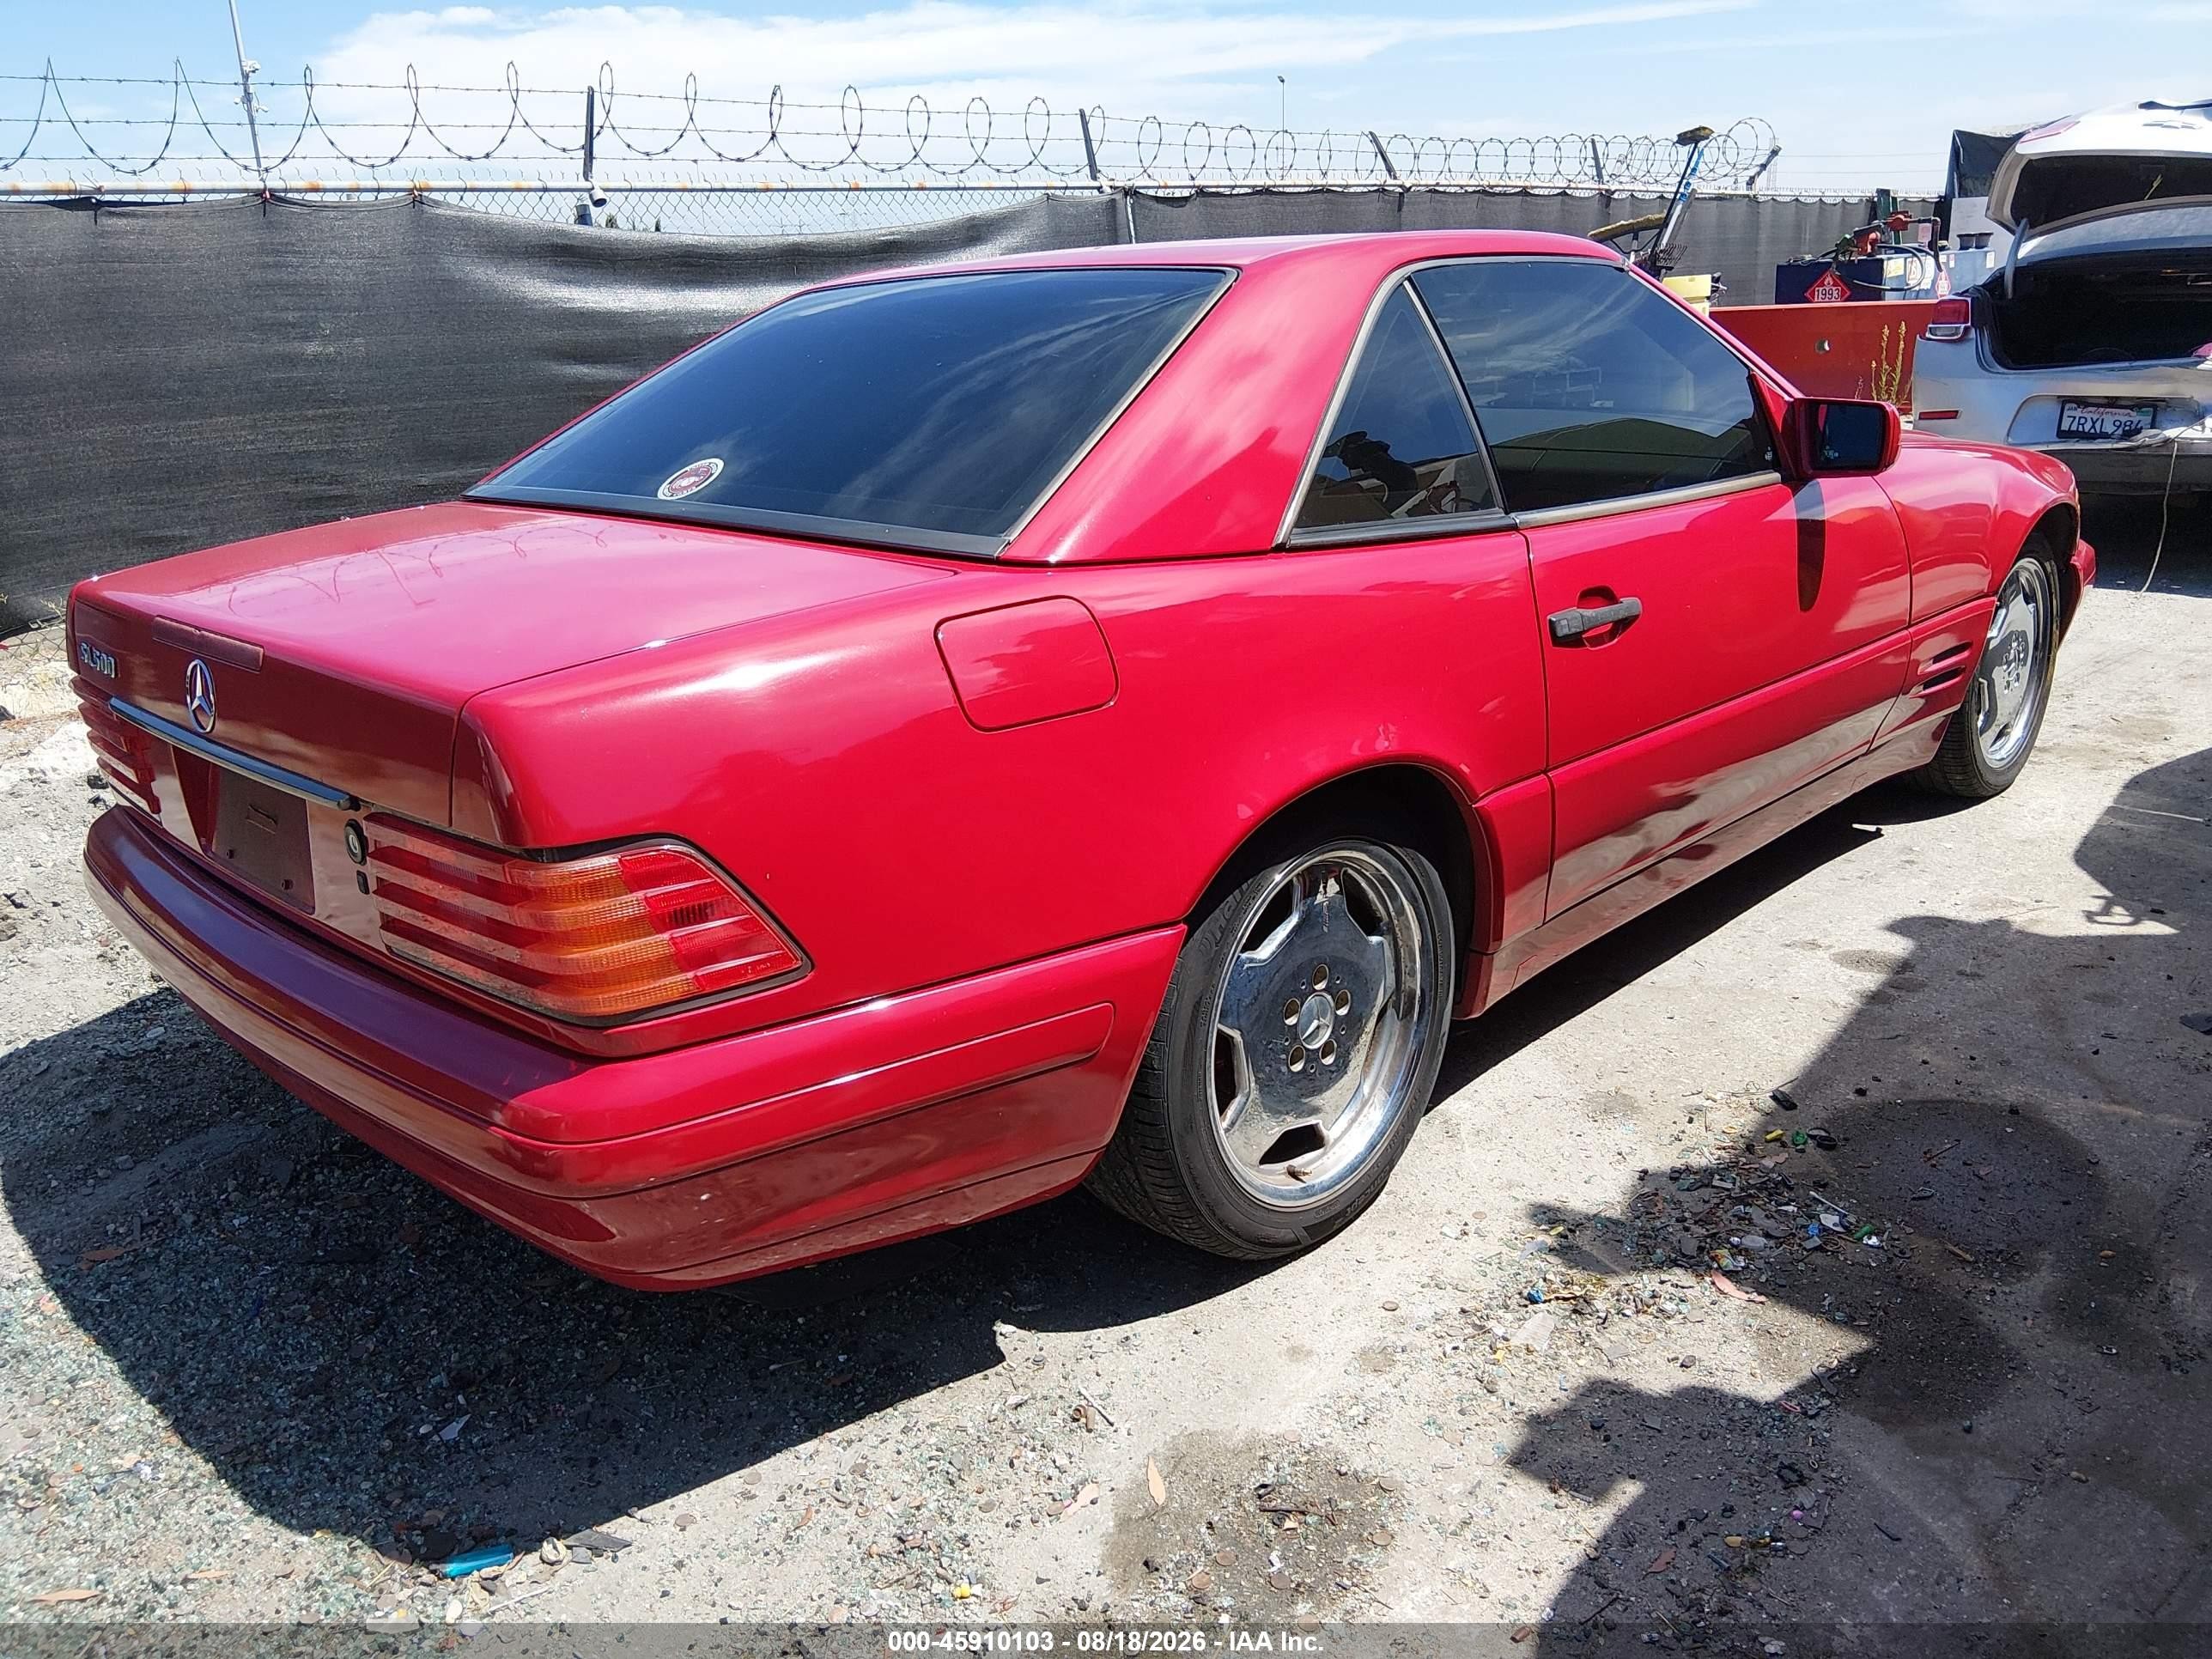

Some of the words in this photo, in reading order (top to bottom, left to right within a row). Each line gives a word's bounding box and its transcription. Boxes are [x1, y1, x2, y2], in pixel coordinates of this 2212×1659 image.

[1816, 288, 1840, 301] 1993
[2081, 406, 2132, 418] California
[80, 641, 115, 678] SL500
